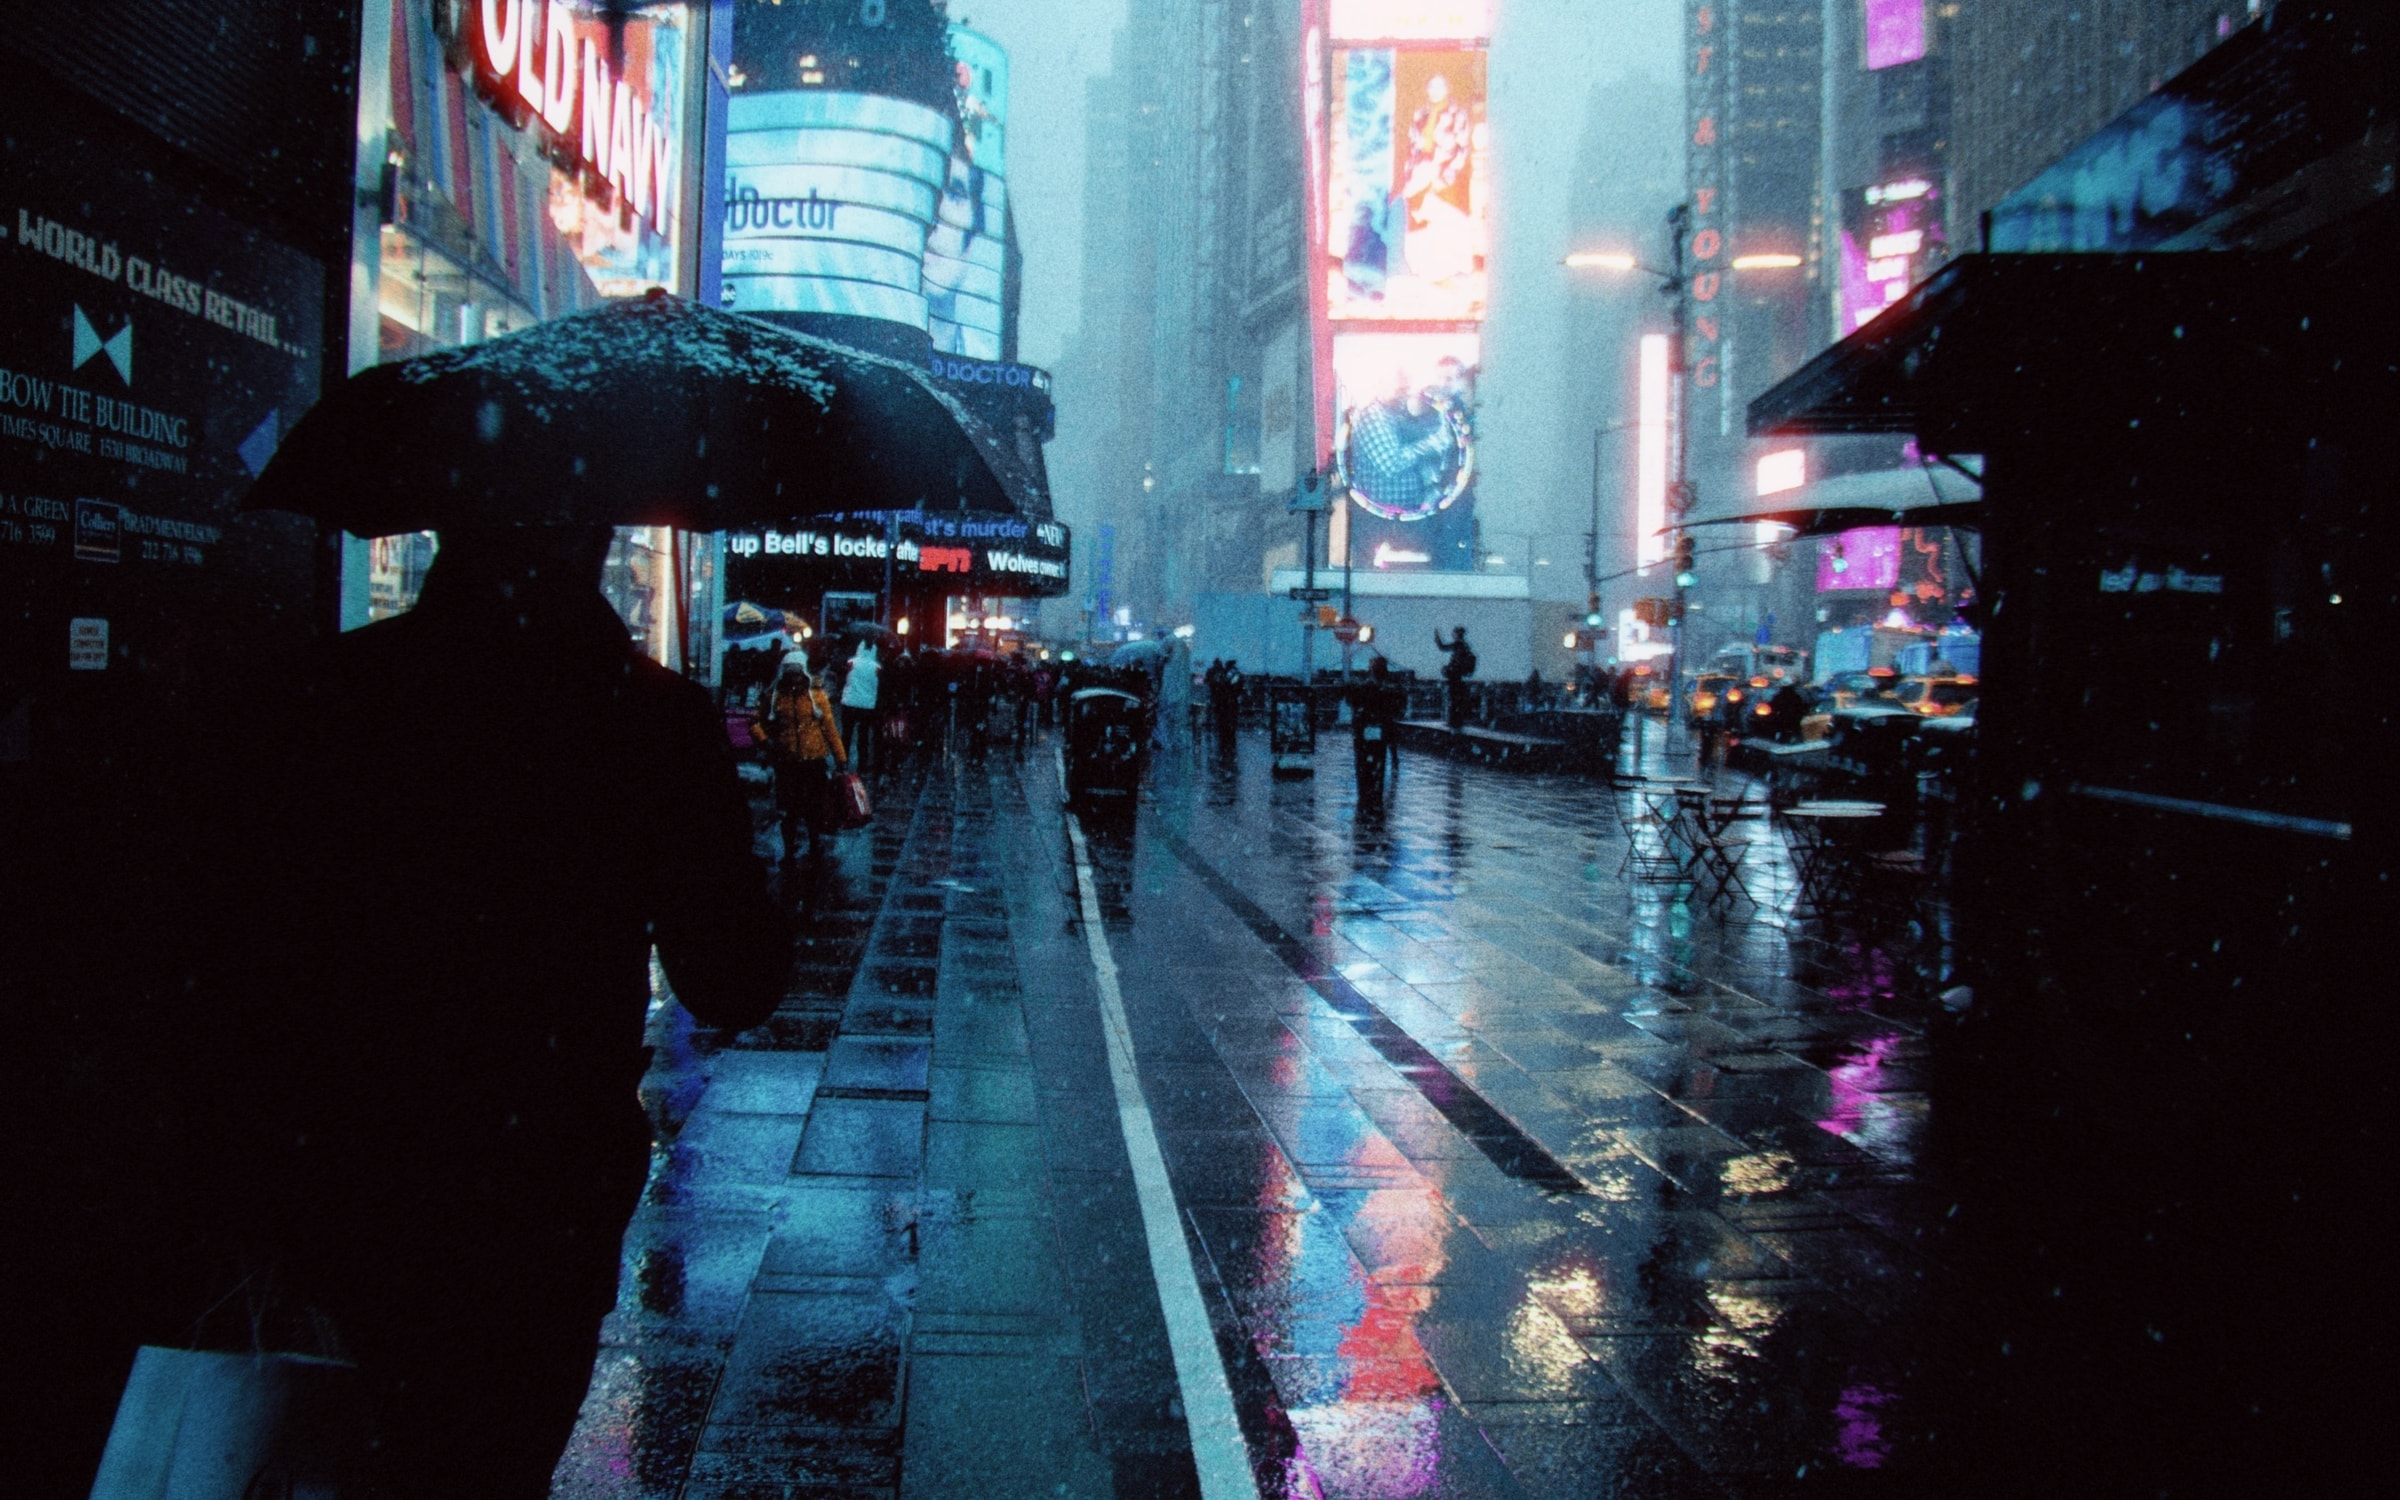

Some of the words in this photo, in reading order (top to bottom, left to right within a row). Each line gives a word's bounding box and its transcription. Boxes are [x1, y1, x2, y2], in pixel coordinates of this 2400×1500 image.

[480, 0, 574, 134] OLD
[581, 37, 672, 237] NAVY
[17, 207, 121, 283] WORLD
[126, 253, 203, 317] CLASS
[1692, 187, 1721, 388] YOUNG
[946, 361, 1030, 388] DOCTOR
[0, 368, 54, 414] BOW
[57, 383, 92, 425] TIE
[95, 394, 188, 449] BUILDING
[125, 442, 188, 475] BROADWAY
[23, 495, 70, 523] GREEN
[730, 534, 760, 558] up
[764, 529, 830, 556] Bell's
[960, 517, 1029, 539] murder
[986, 549, 1039, 575] Wolves
